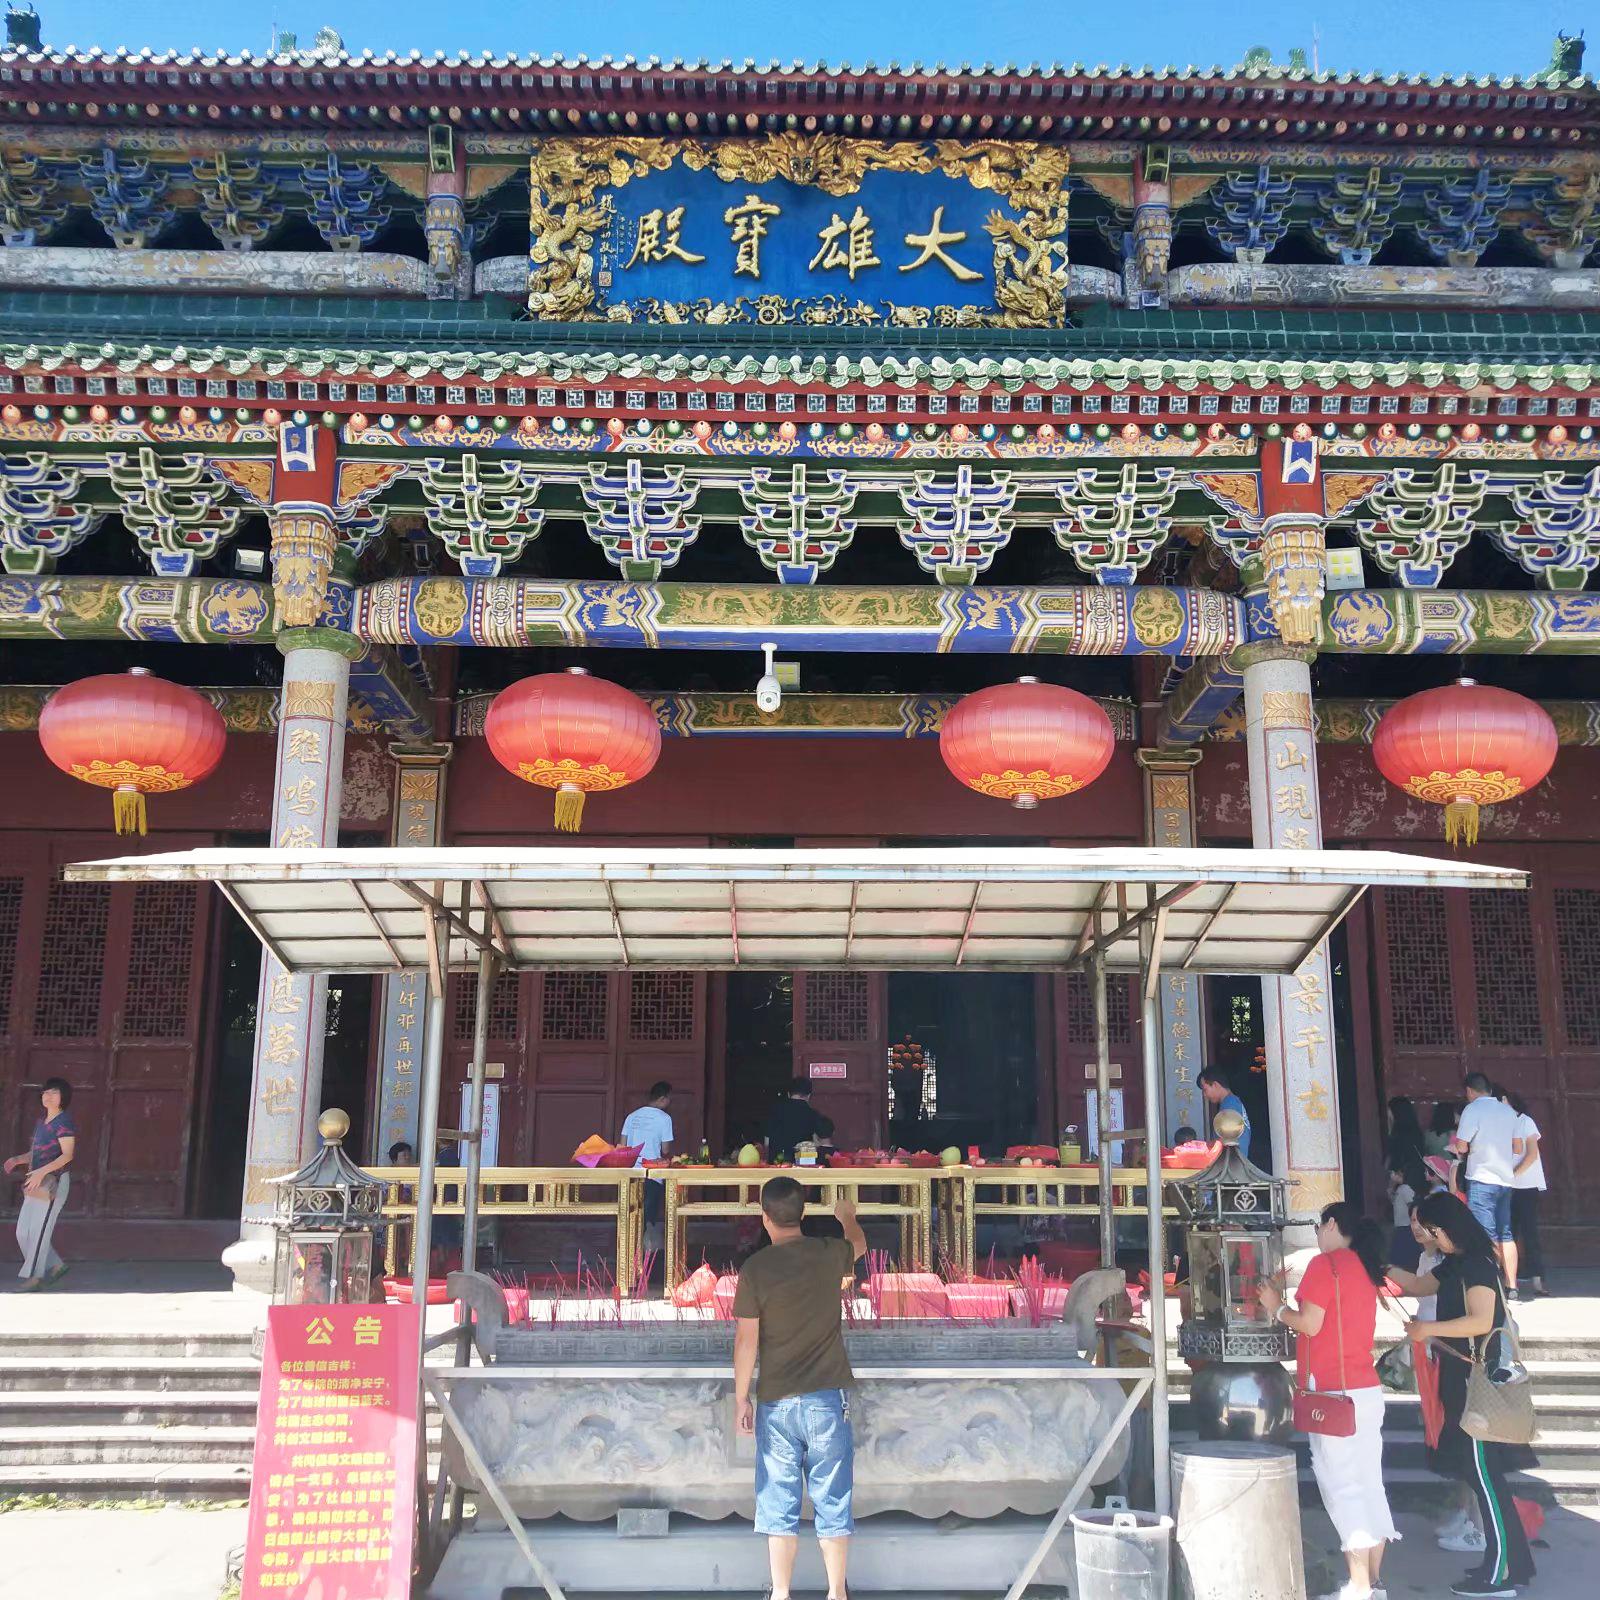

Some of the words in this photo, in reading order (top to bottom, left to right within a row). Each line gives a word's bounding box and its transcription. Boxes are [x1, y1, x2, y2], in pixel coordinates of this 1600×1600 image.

[625, 194, 984, 281] 大雄寶殿
[305, 1316, 383, 1345] 公告
